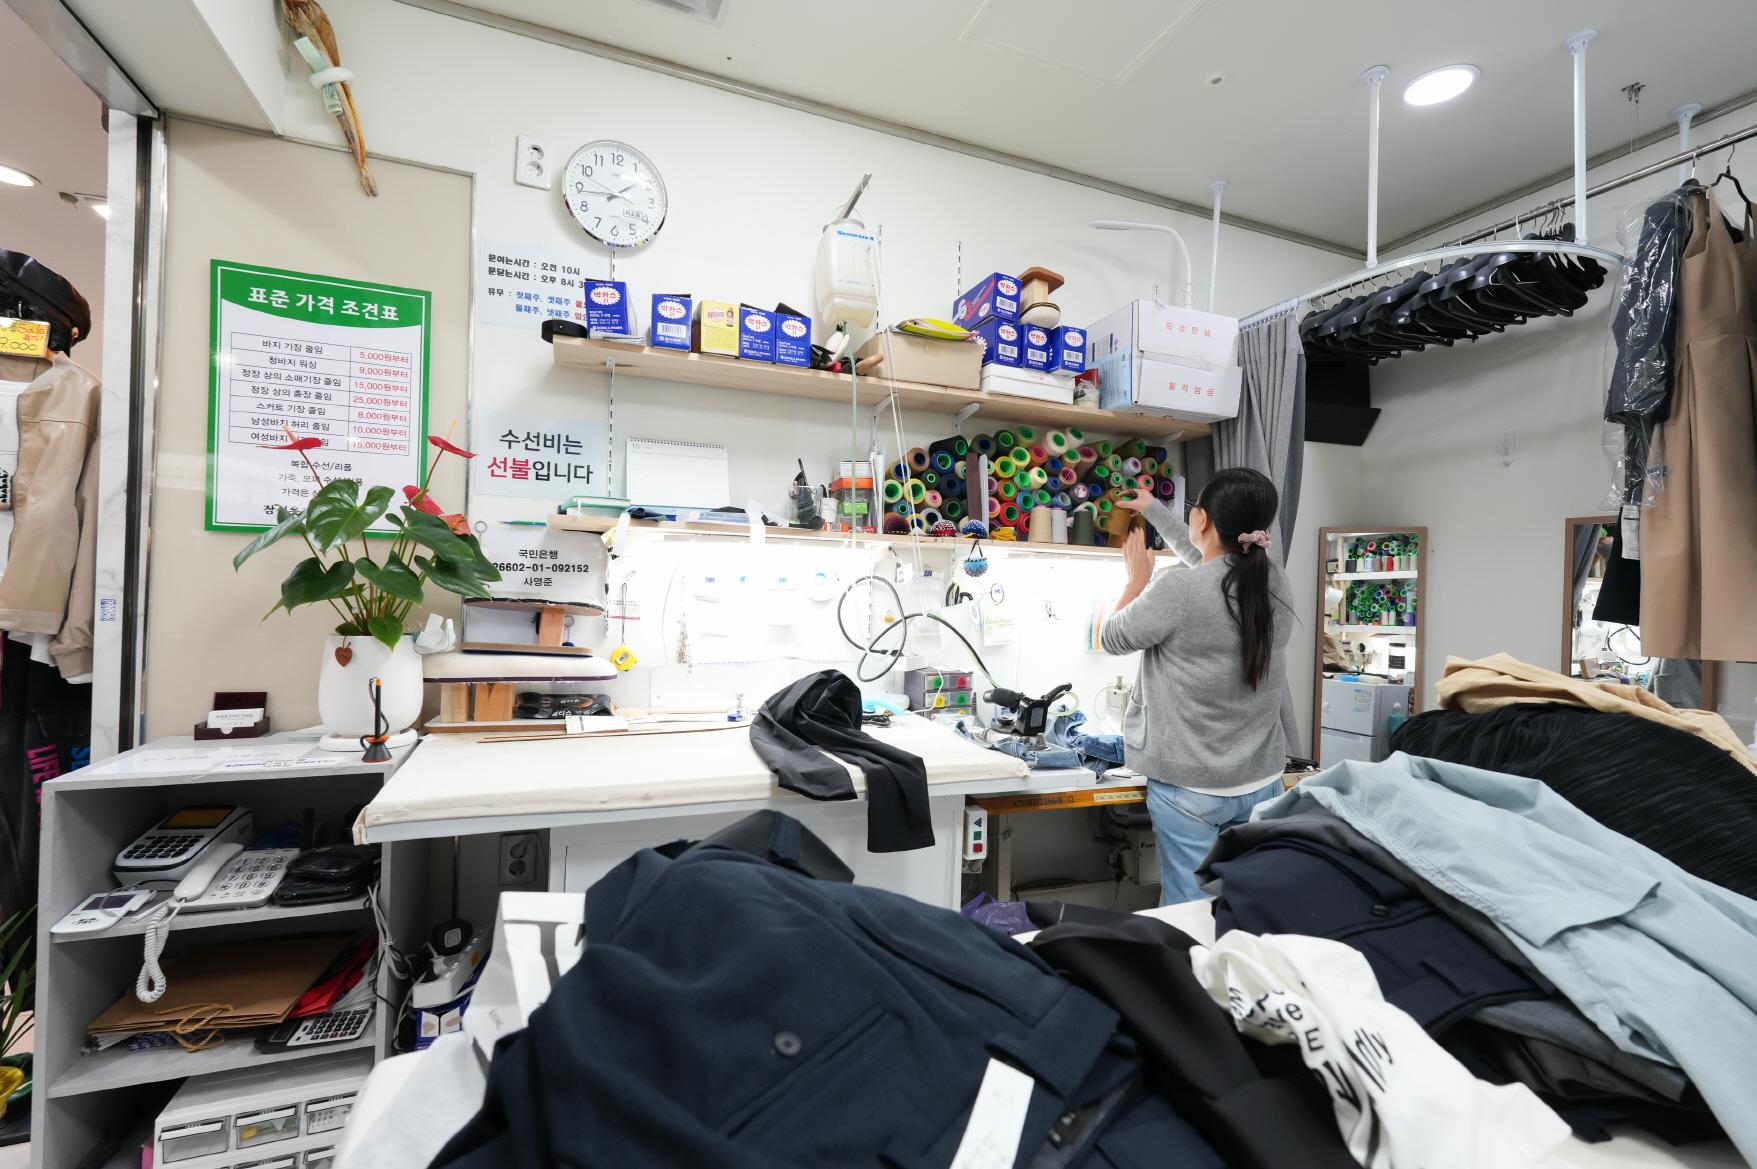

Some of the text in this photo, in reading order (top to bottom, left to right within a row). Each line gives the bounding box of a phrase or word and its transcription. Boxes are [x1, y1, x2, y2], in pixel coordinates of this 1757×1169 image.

[593, 153, 604, 167] 11
[611, 152, 625, 167] 12
[581, 164, 593, 177] 10
[575, 181, 584, 194] 9
[579, 200, 589, 213] 8
[594, 216, 602, 229] 7
[610, 224, 620, 237] 6
[628, 223, 637, 236] 5
[488, 253, 530, 268] 문여는시간
[541, 262, 557, 273] 오전
[561, 265, 580, 276] 10시
[488, 266, 530, 281] 문닫는시간
[541, 274, 557, 285] 오후
[560, 278, 575, 288] 8시
[593, 291, 617, 299] 박카스
[248, 287, 400, 321] 표준 가격 조견표
[660, 305, 683, 314] 박카스
[748, 317, 769, 327] 박카스
[784, 322, 804, 333] 박카스
[18, 323, 45, 335] Sale
[499, 429, 583, 456] 수선비는
[487, 456, 594, 485] 선불입니다
[281, 488, 309, 498] 가격은
[518, 549, 559, 560] 국민은행
[523, 577, 553, 587] 사영준
